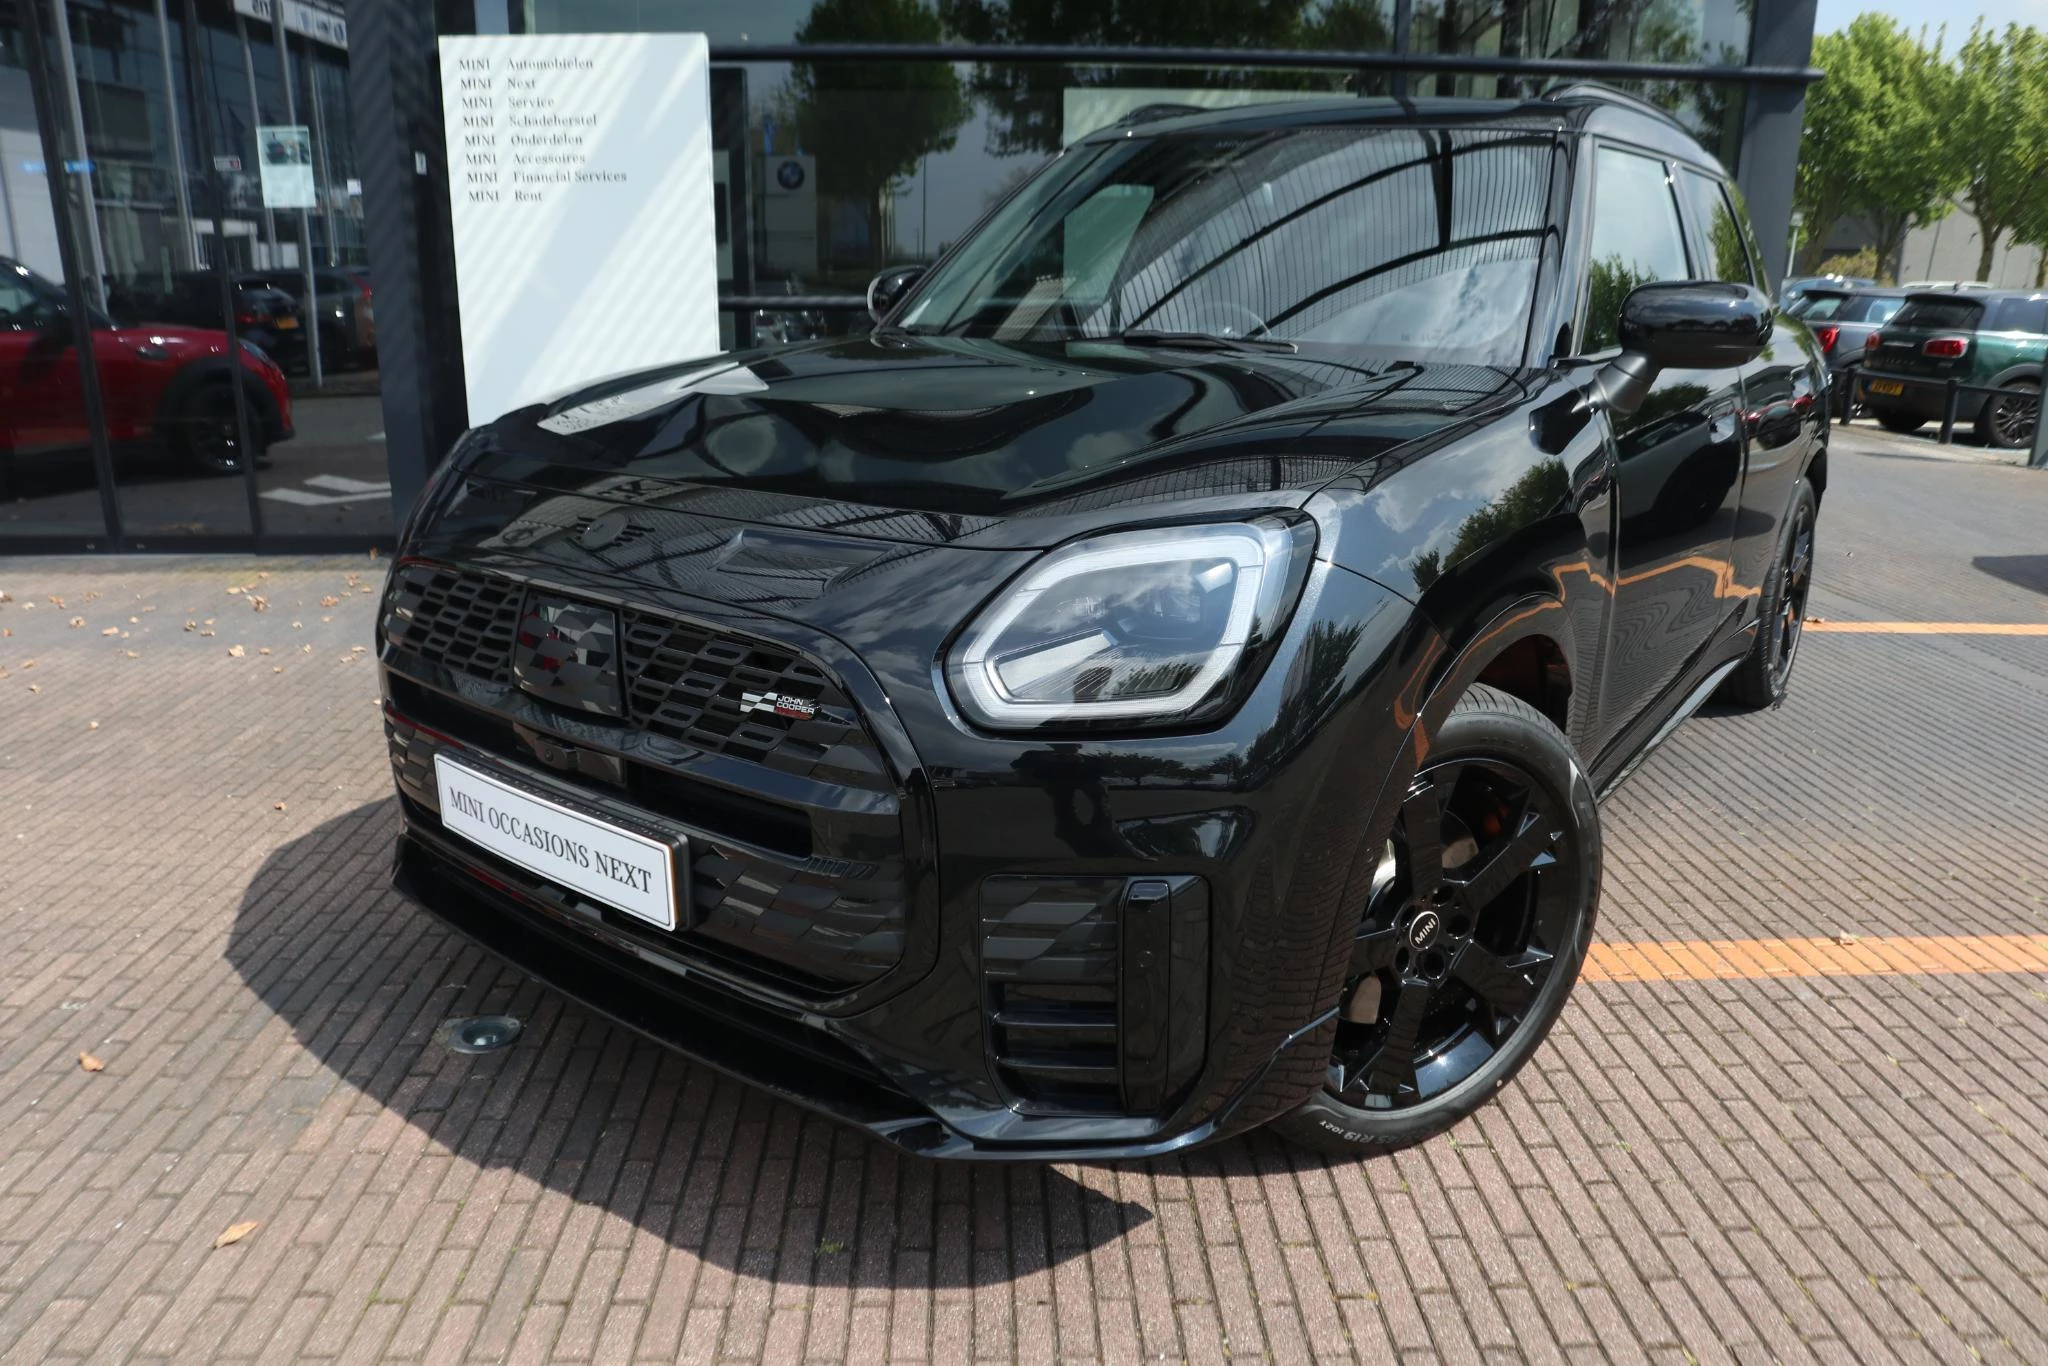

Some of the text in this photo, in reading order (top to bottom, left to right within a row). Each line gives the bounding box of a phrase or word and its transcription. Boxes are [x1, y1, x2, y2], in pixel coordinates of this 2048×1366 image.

[459, 56, 593, 70] MINI Automobielen
[461, 79, 536, 89] MINI Next
[462, 97, 554, 108] MINI Service
[463, 114, 597, 127] MINI Schadeherstel
[464, 133, 583, 146] MINI Onderdelen
[466, 153, 585, 165] MINI Accessoires
[467, 171, 627, 184] MINI Financial Services
[468, 191, 543, 202] MINI Rent
[777, 695, 804, 706] JOHN
[776, 701, 815, 715] COOPER
[450, 787, 652, 894] MINI OCCASIONS NEXT
[1414, 918, 1436, 944] MINI
